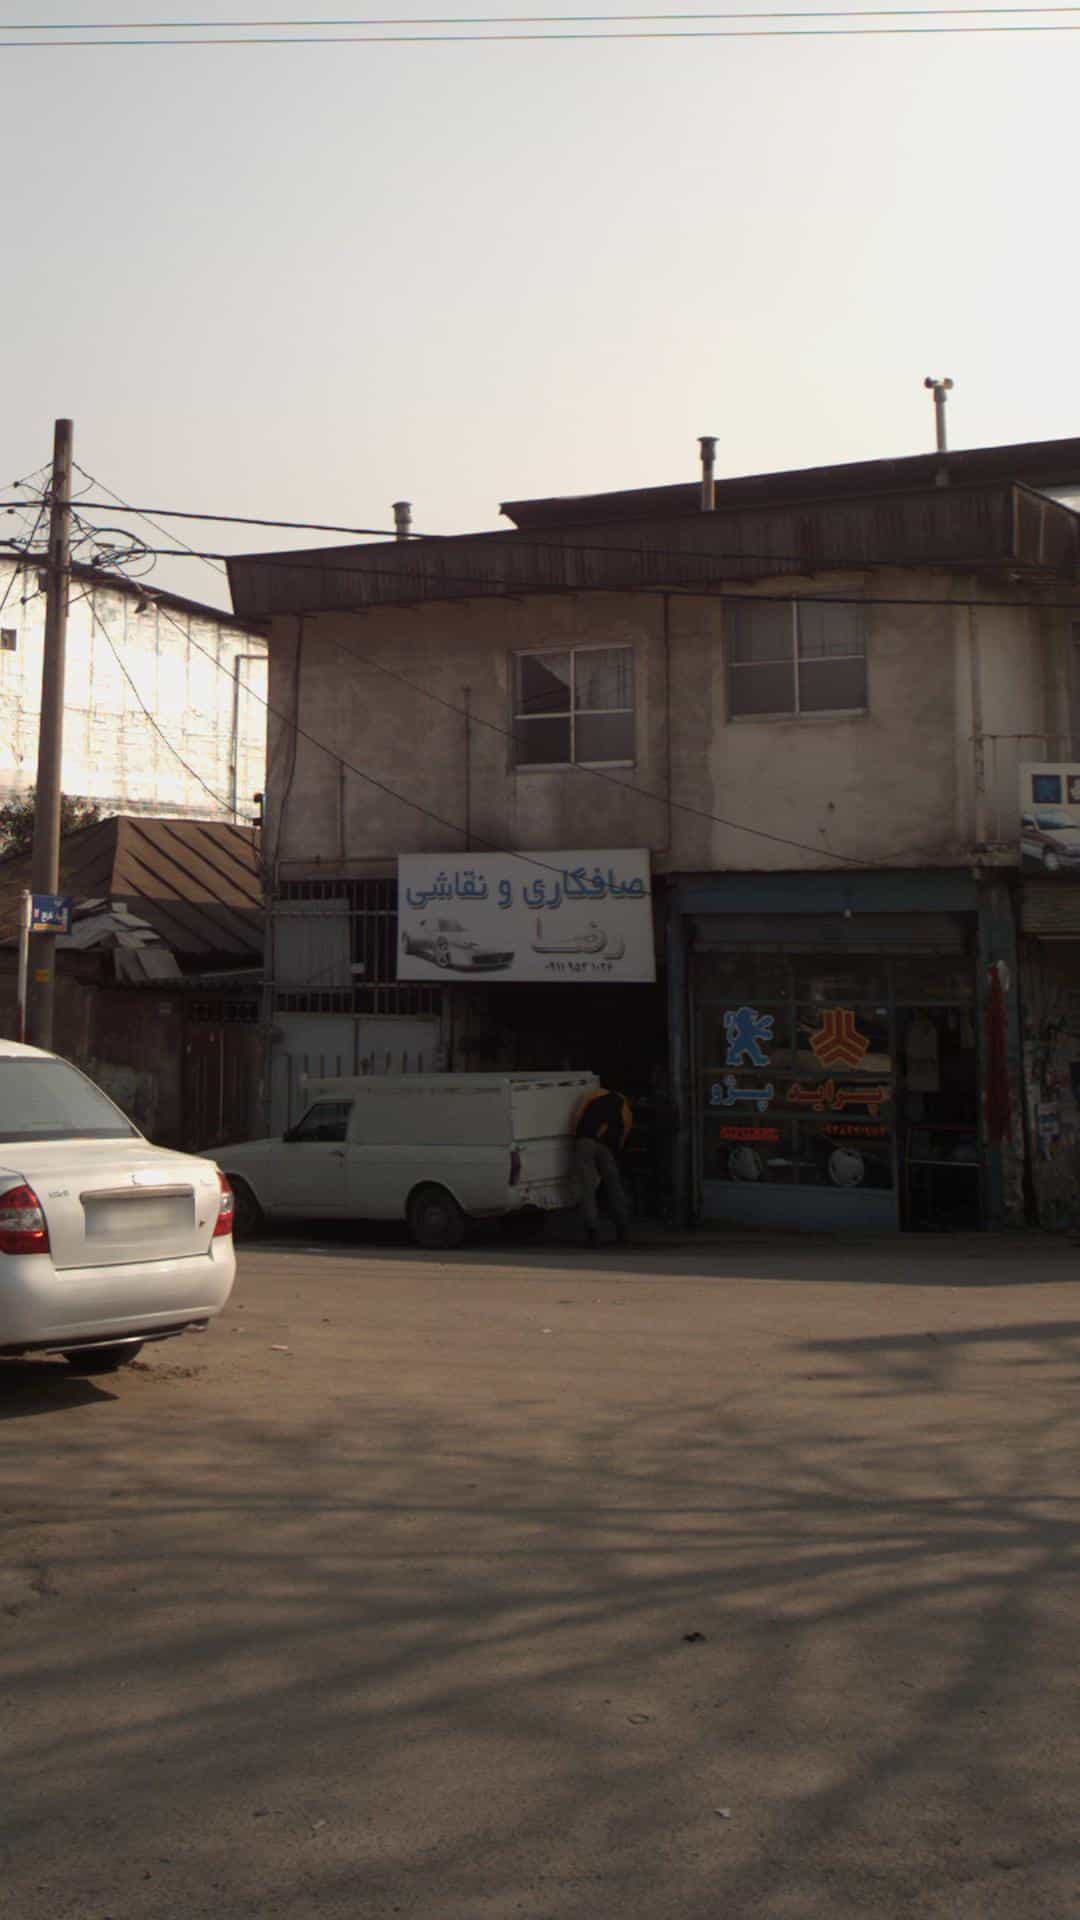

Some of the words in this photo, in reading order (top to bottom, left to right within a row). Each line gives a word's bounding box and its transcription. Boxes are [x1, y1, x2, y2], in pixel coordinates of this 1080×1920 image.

[406, 870, 488, 909] نقاشی
[498, 879, 512, 909] و
[531, 916, 626, 960] رضا
[710, 1074, 775, 1112] پژو
[786, 1078, 889, 1118] پراید
